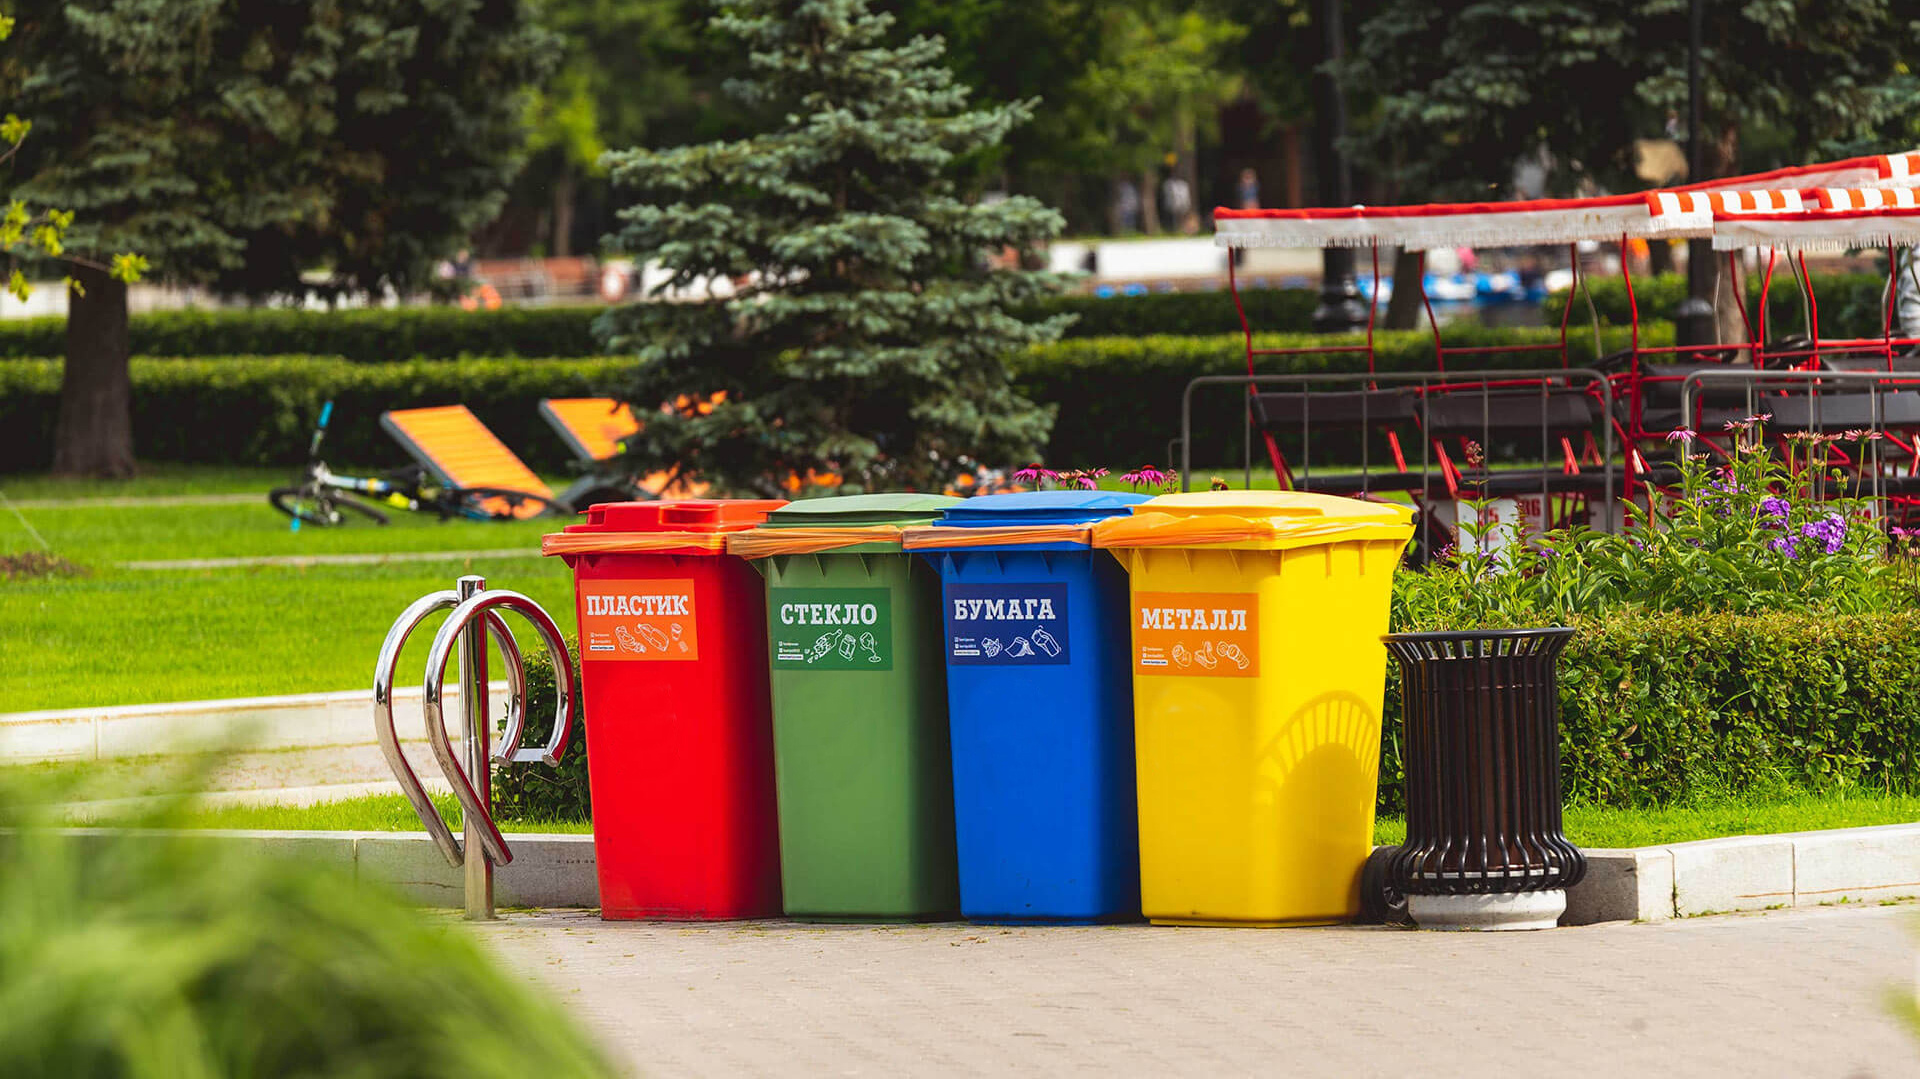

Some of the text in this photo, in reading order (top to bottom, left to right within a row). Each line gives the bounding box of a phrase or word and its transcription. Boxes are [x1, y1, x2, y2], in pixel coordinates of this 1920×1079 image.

[586, 595, 689, 616] ПЛАСТИК
[780, 603, 878, 625] СТЕКЛО
[954, 598, 1056, 620] БУМАГА
[1141, 608, 1247, 631] МЕТАЛЛ
